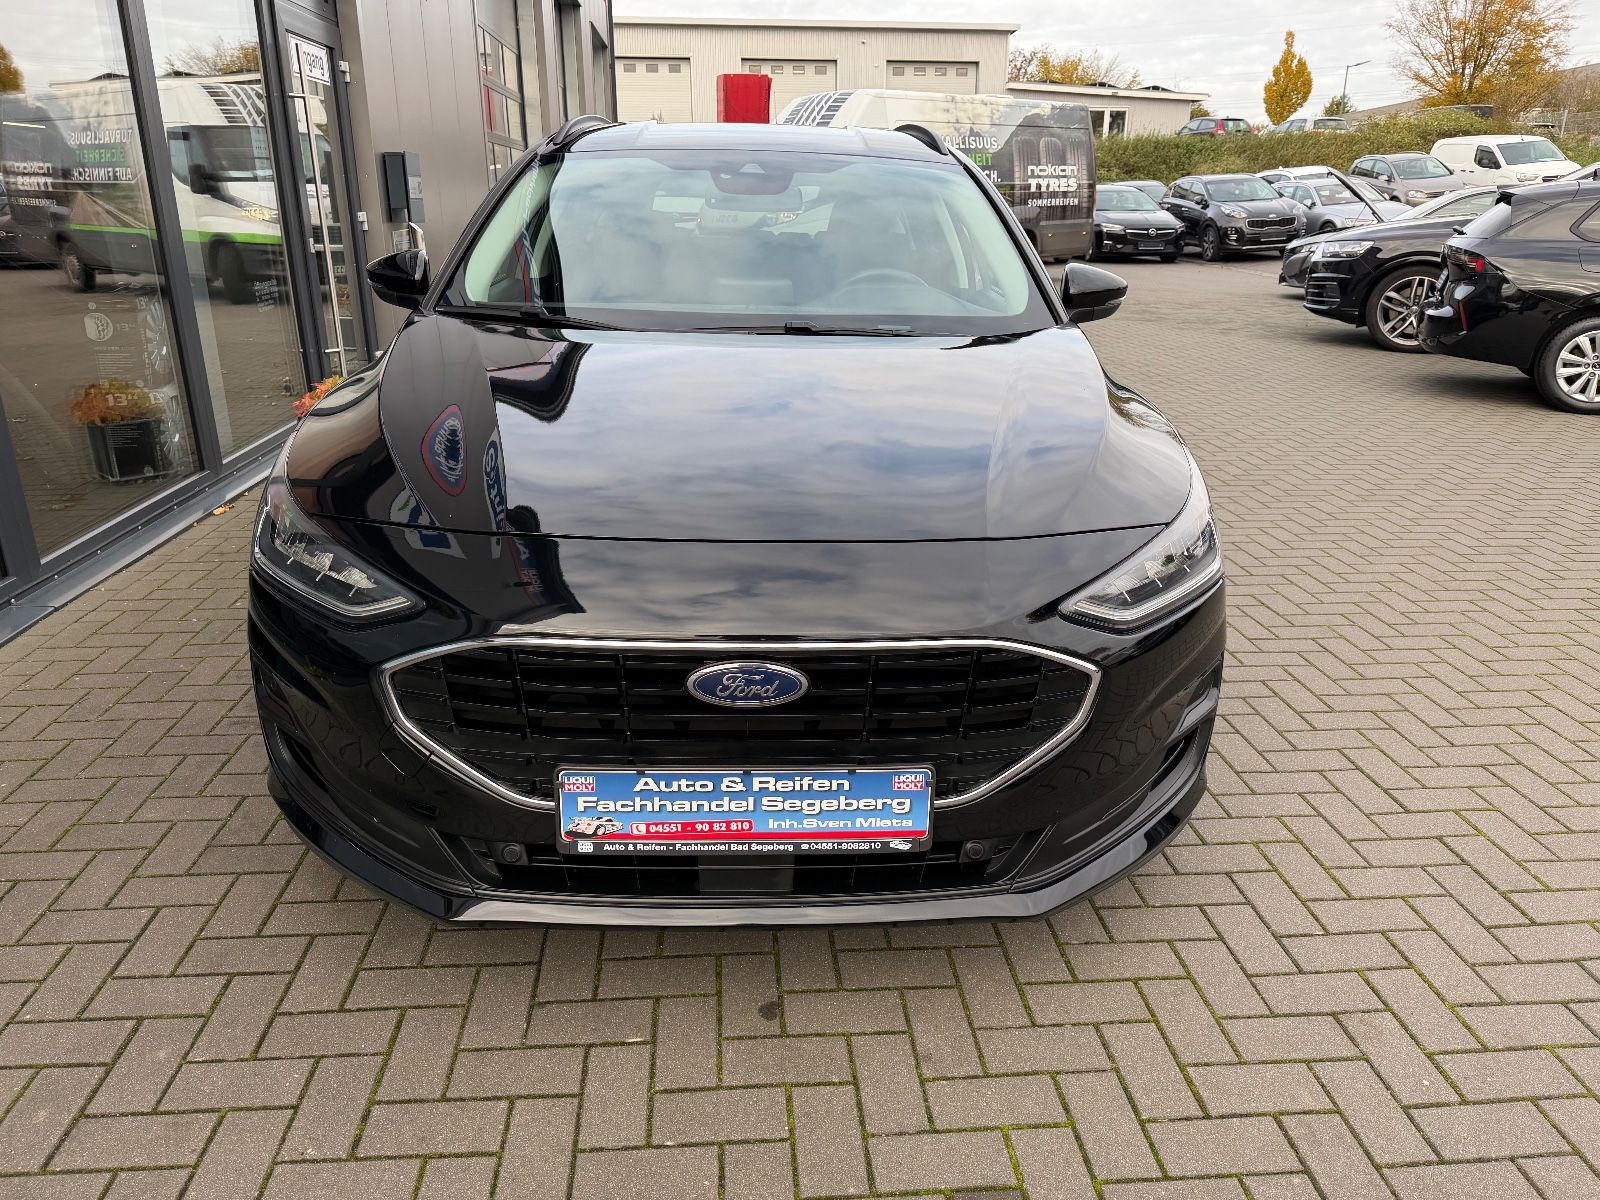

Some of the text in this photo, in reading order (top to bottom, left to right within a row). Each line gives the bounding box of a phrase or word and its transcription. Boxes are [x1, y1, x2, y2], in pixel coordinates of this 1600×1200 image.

[941, 135, 1001, 149] ALLISUUS.
[1027, 164, 1079, 176] nokian
[1028, 178, 1078, 192] TYRES
[1027, 197, 1079, 208] SOMMERREIFEN
[716, 673, 780, 698] Ford
[564, 784, 594, 792] MOLY
[633, 776, 850, 792] Auto & Reifen
[894, 782, 924, 790] MOLY
[577, 796, 911, 815] Fachhandel Segeberg
[649, 823, 682, 833] 04551
[695, 822, 710, 832] 90
[713, 822, 727, 831] 82
[730, 821, 750, 831] 810
[604, 843, 625, 851] Auto
[627, 843, 635, 851] &
[637, 843, 667, 851] Reifen
[675, 843, 729, 851] Fachhandel
[730, 843, 749, 851] Bad
[750, 843, 794, 852] Segeberg
